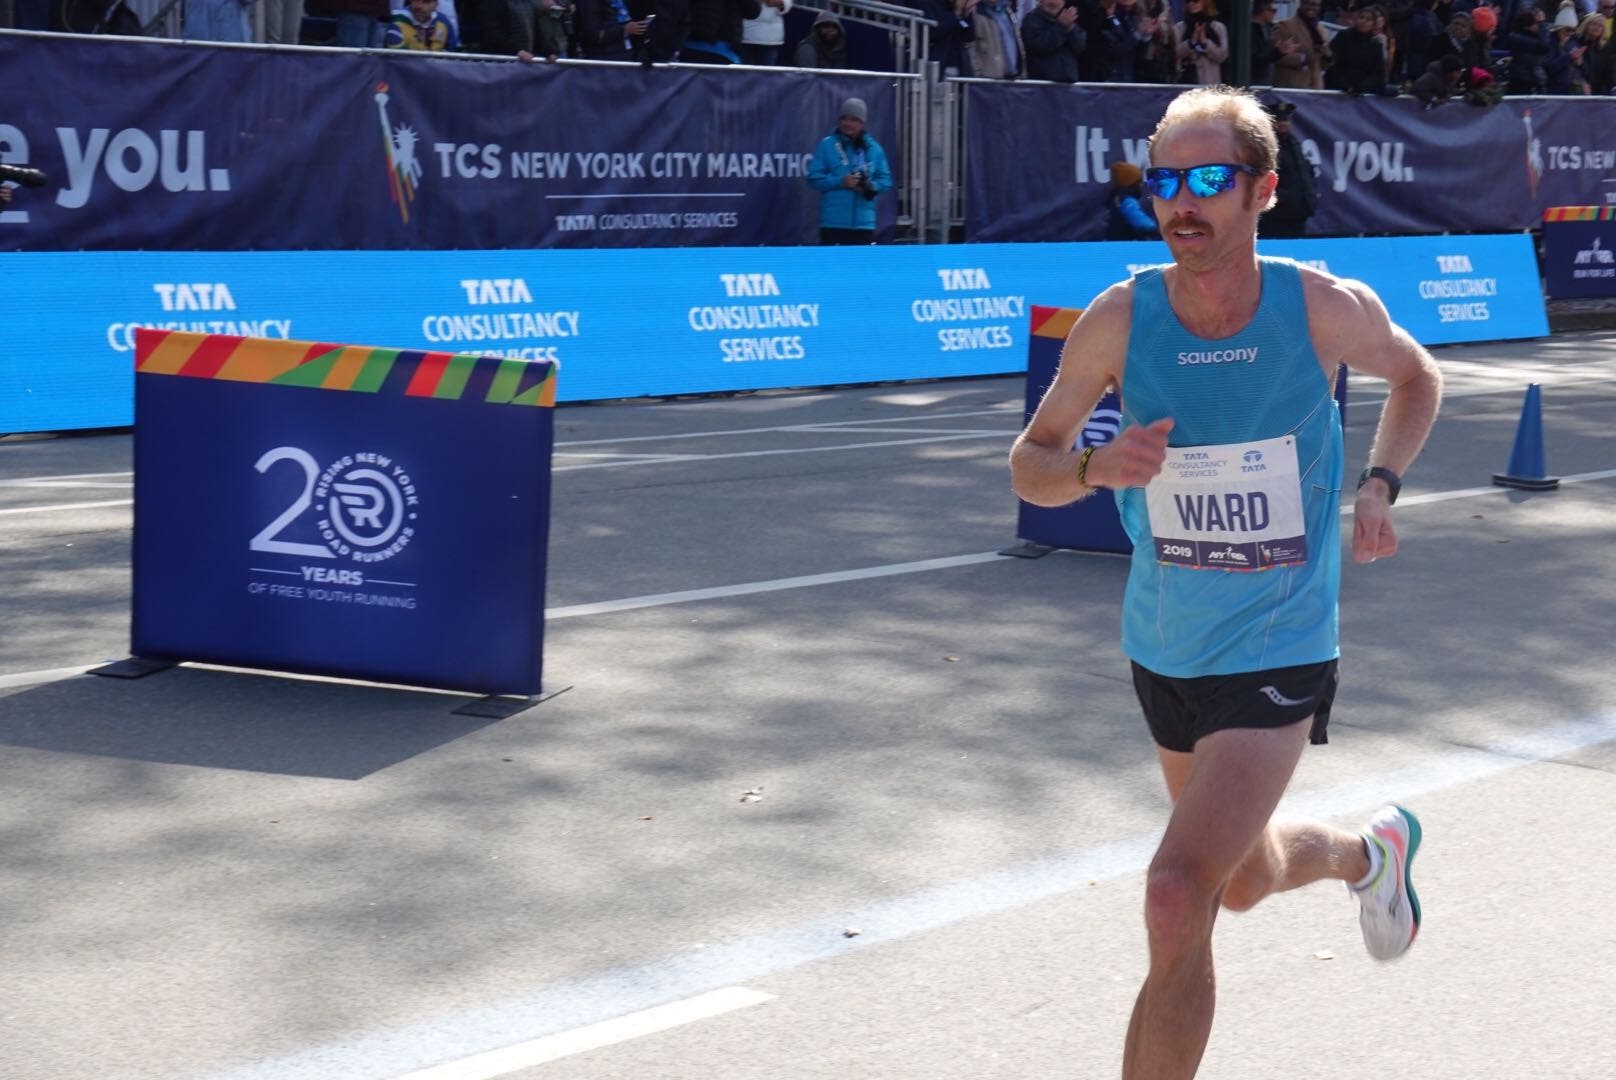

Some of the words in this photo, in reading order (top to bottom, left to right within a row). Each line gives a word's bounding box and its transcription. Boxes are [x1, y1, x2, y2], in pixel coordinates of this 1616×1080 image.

[55, 127, 231, 208] you.
[434, 143, 501, 179] TCS
[511, 151, 570, 178] NEW
[575, 152, 645, 179] YORK
[651, 152, 702, 178] CITY
[1075, 125, 1111, 184] It
[1332, 140, 1414, 193] you.
[1548, 145, 1582, 170] TCS
[1584, 150, 1616, 170] NEW
[555, 215, 596, 231] TATA
[600, 213, 682, 230] CONSULTANCY
[683, 212, 738, 228] SERVICES
[1436, 255, 1473, 273] TATA
[460, 278, 534, 304] TATA
[720, 273, 781, 297] TATA
[937, 268, 991, 291] TATA
[1419, 278, 1497, 299] CONSULTANCY
[153, 283, 237, 311] TATA
[911, 296, 1025, 322] CONSULTANCY
[688, 304, 819, 331] CONSULTANCY
[1438, 302, 1490, 322] SERVICES
[107, 319, 292, 352] COTANCY
[422, 311, 579, 342] CONSULTANCY
[937, 326, 1013, 352] SERVICES
[720, 336, 805, 362] SERVICES
[1177, 346, 1259, 367] saucony
[1183, 452, 1209, 461] TATA
[1241, 463, 1267, 473] TATA
[315, 455, 353, 498] RISING
[355, 452, 393, 468] NEW
[392, 465, 419, 506] YORK
[1179, 469, 1219, 479] SERVICES
[1173, 491, 1270, 533] WARD
[317, 519, 350, 556] ROAD
[1162, 544, 1193, 558] 2019
[301, 565, 364, 586] YEARS
[248, 582, 268, 594] OF
[269, 584, 304, 599] FREE
[306, 589, 353, 602] YOUTH
[354, 592, 417, 609] RUNNING
